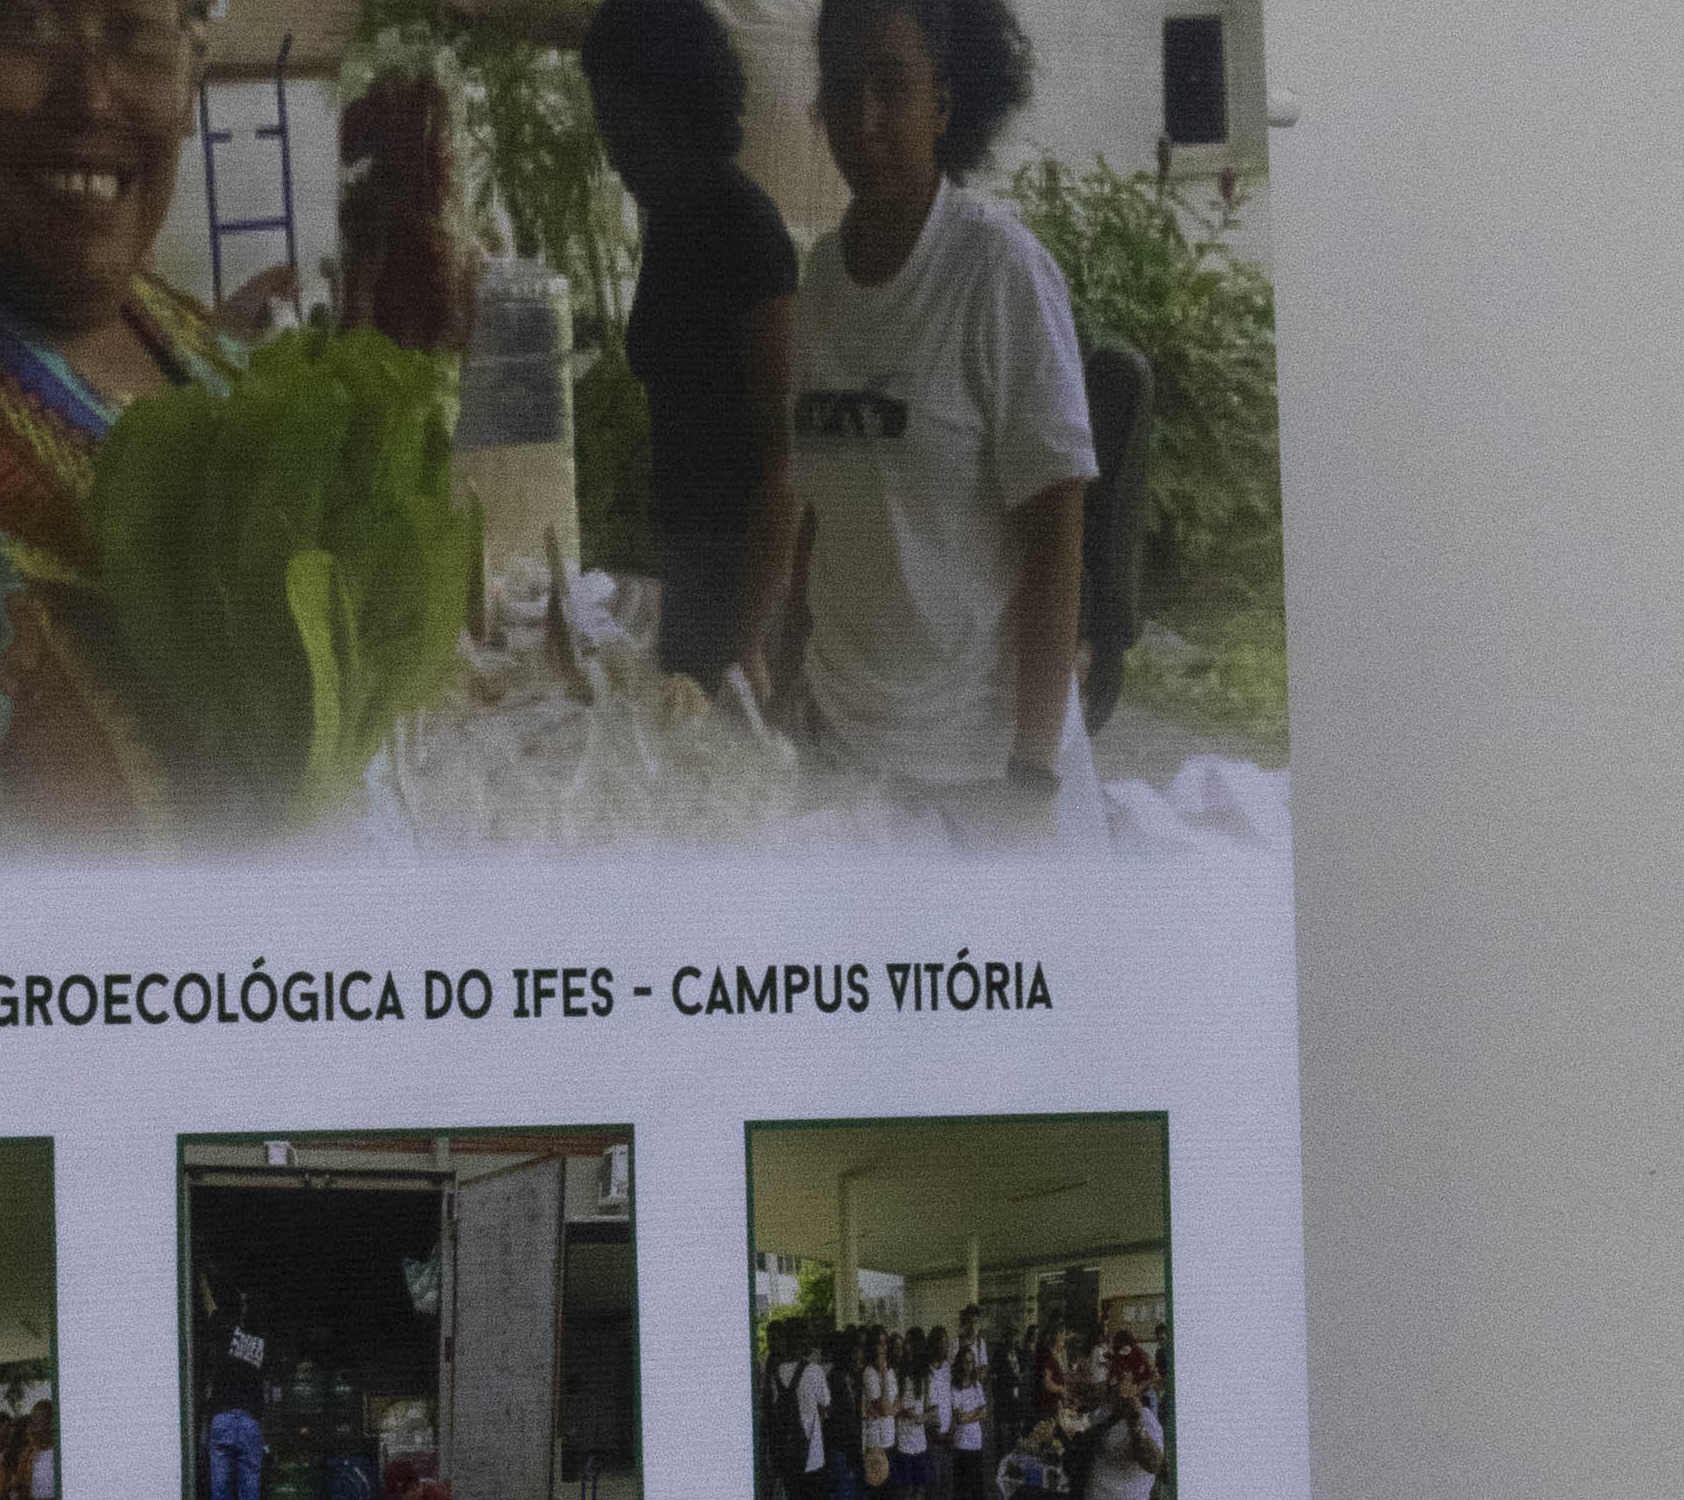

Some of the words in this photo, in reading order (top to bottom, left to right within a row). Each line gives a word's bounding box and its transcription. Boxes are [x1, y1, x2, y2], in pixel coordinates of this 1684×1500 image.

[424, 969, 494, 1021] DO
[512, 967, 615, 1019] IFES
[671, 962, 871, 1015] CAMPUS
[886, 946, 1054, 1013] VITÓRIA
